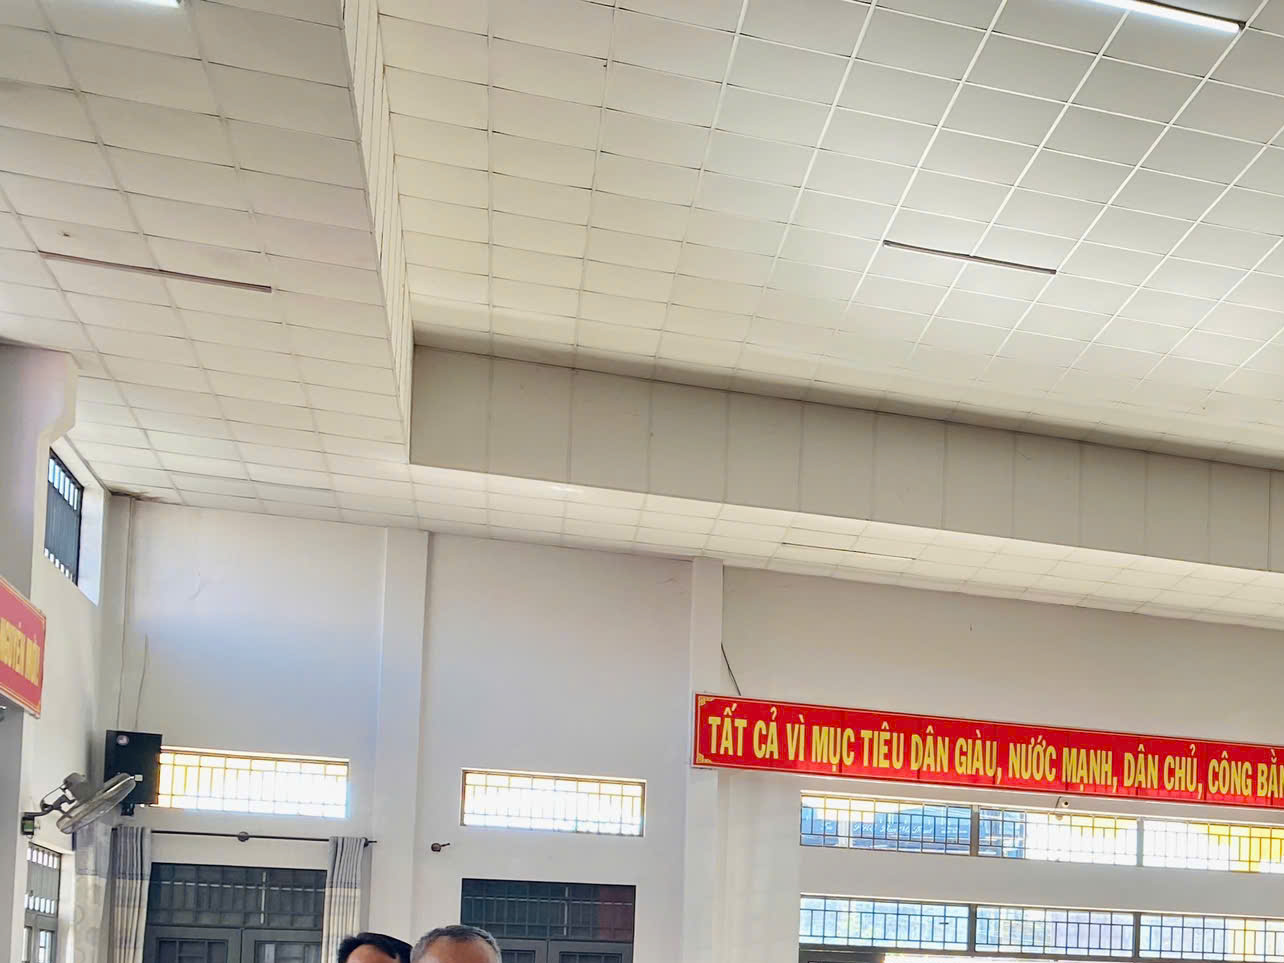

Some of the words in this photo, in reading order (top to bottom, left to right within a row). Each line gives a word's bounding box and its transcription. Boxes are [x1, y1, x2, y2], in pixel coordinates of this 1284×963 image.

[708, 703, 748, 757] TẤT
[753, 707, 779, 760] CẢ
[786, 714, 806, 762] VÌ
[811, 726, 856, 772] MỤC
[860, 721, 905, 770] TIÊU
[909, 725, 950, 773] DÂN
[954, 729, 1002, 784] GIÀU,
[1009, 735, 1057, 783] NƯỚC
[1062, 747, 1118, 793] MẠNH,
[1123, 743, 1159, 790] DÂN
[1163, 743, 1203, 800] CHỦ,
[1207, 751, 1253, 796] CÔNG
